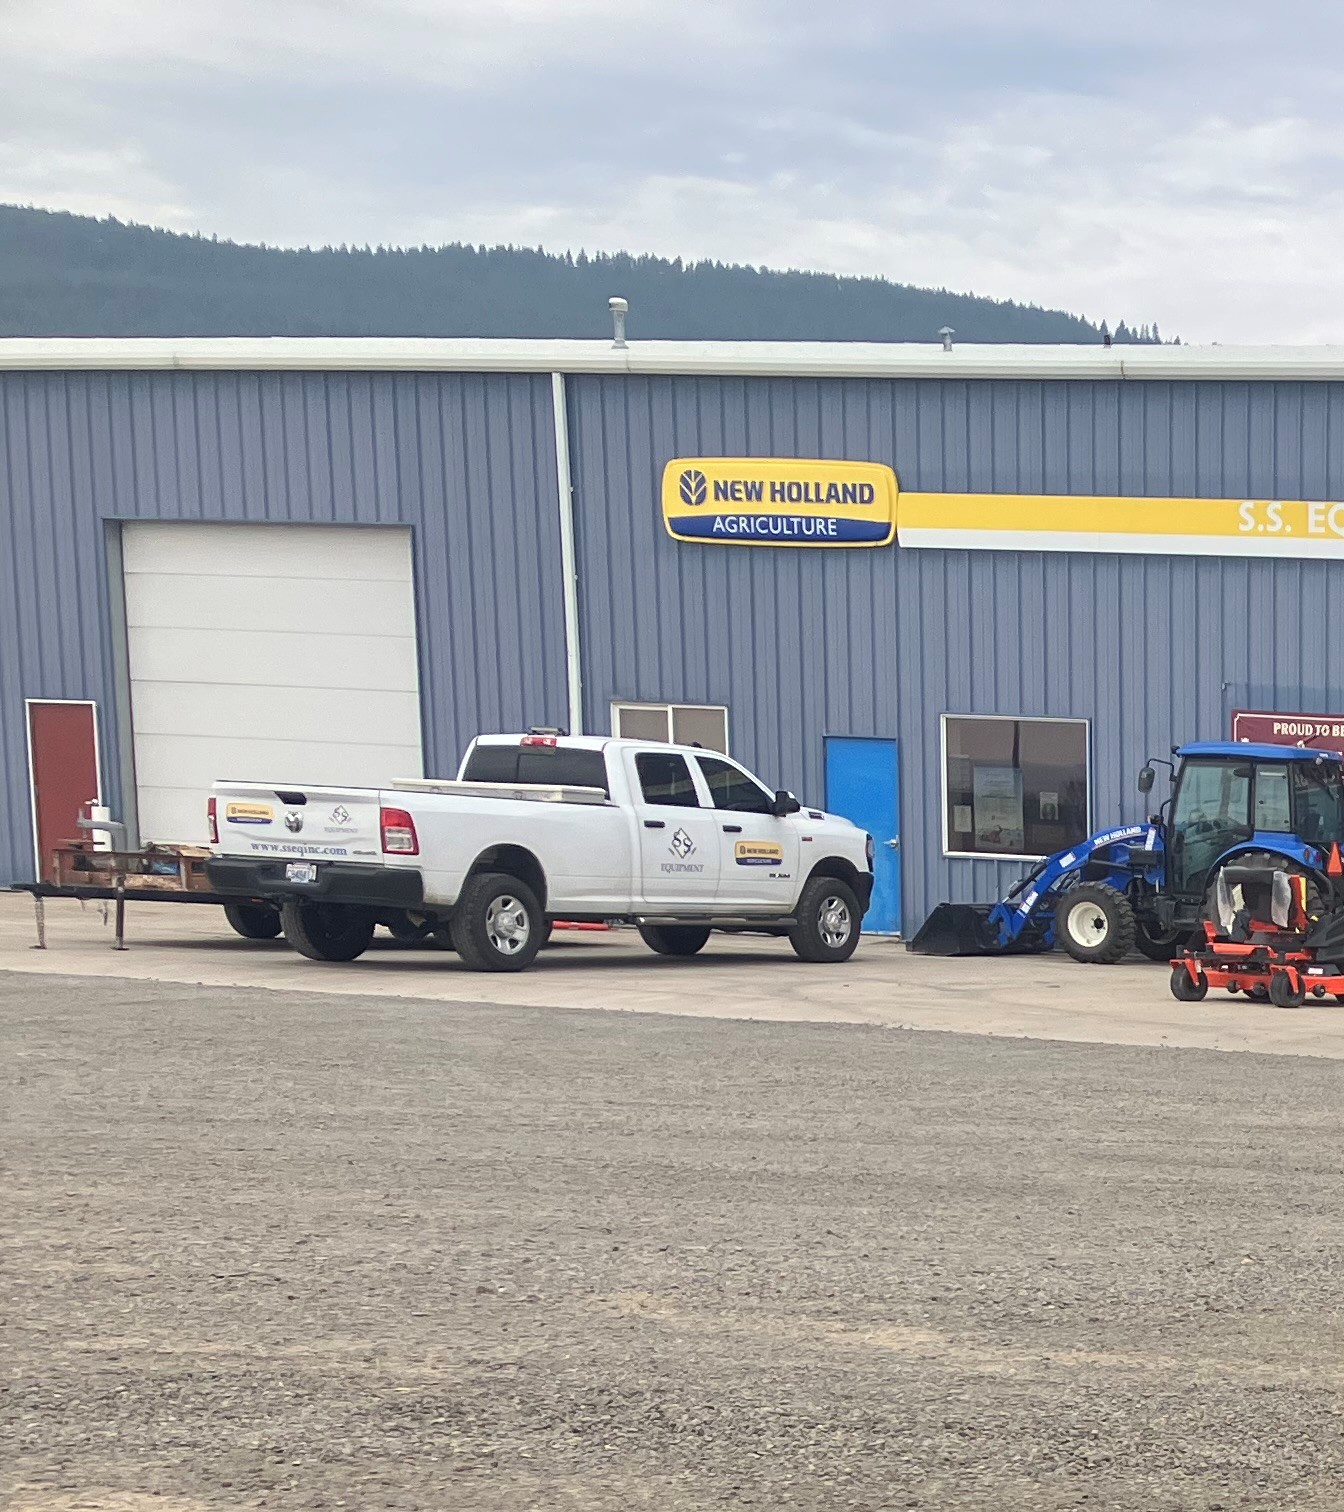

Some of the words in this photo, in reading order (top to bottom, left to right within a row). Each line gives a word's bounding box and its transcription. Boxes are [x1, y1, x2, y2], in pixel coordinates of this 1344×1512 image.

[713, 479, 764, 502] NEW
[769, 481, 875, 505] HOLLAND
[1238, 501, 1292, 533] S.S.
[712, 516, 838, 536] AGRICULTURE
[1273, 722, 1313, 737] PROUD
[1315, 724, 1330, 737] TO
[1094, 834, 1110, 845] NEW
[251, 842, 348, 857] www.sseqinc.com
[660, 863, 705, 874] EQUIPMENT
